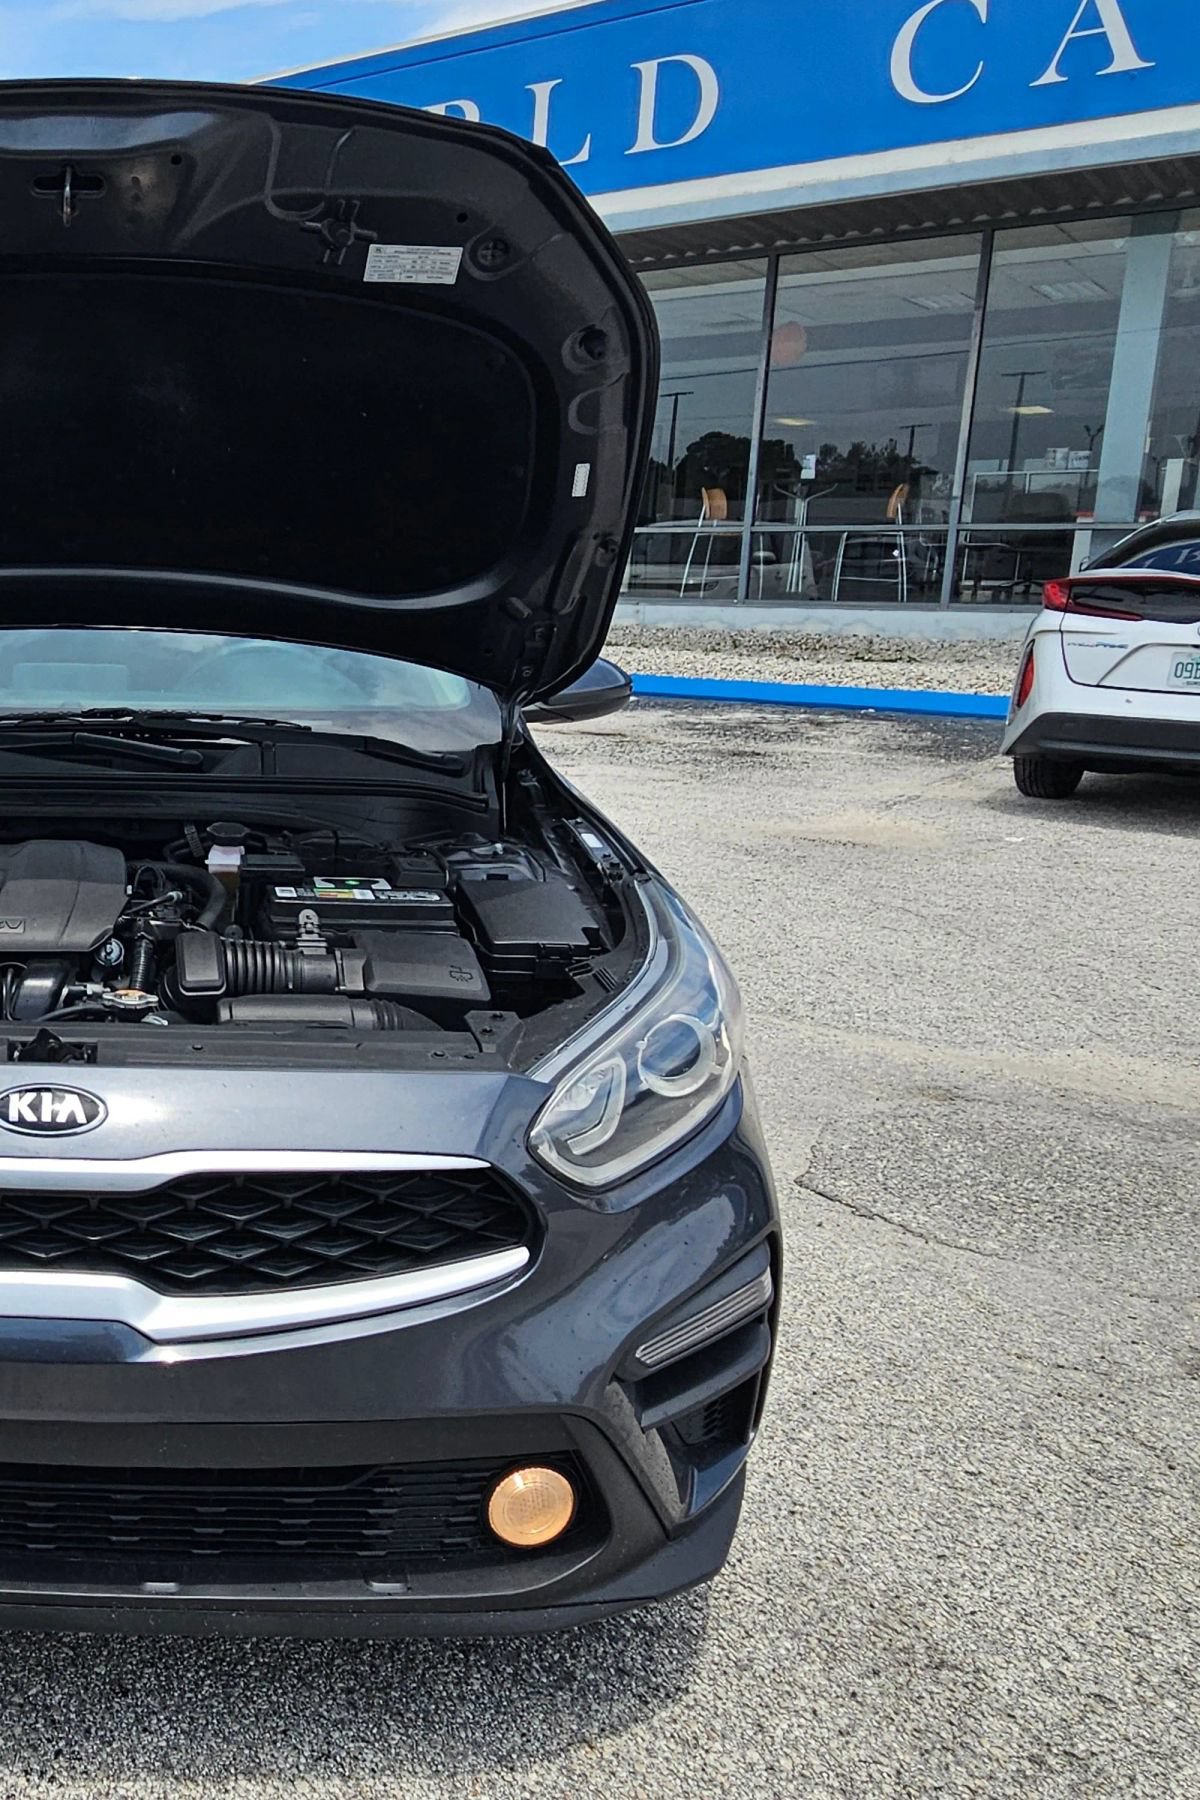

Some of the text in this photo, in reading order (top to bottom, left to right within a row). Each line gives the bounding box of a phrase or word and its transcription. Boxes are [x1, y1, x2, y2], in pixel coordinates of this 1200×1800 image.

[421, 0, 1157, 167] LD CA
[8, 1091, 88, 1124] KIA
